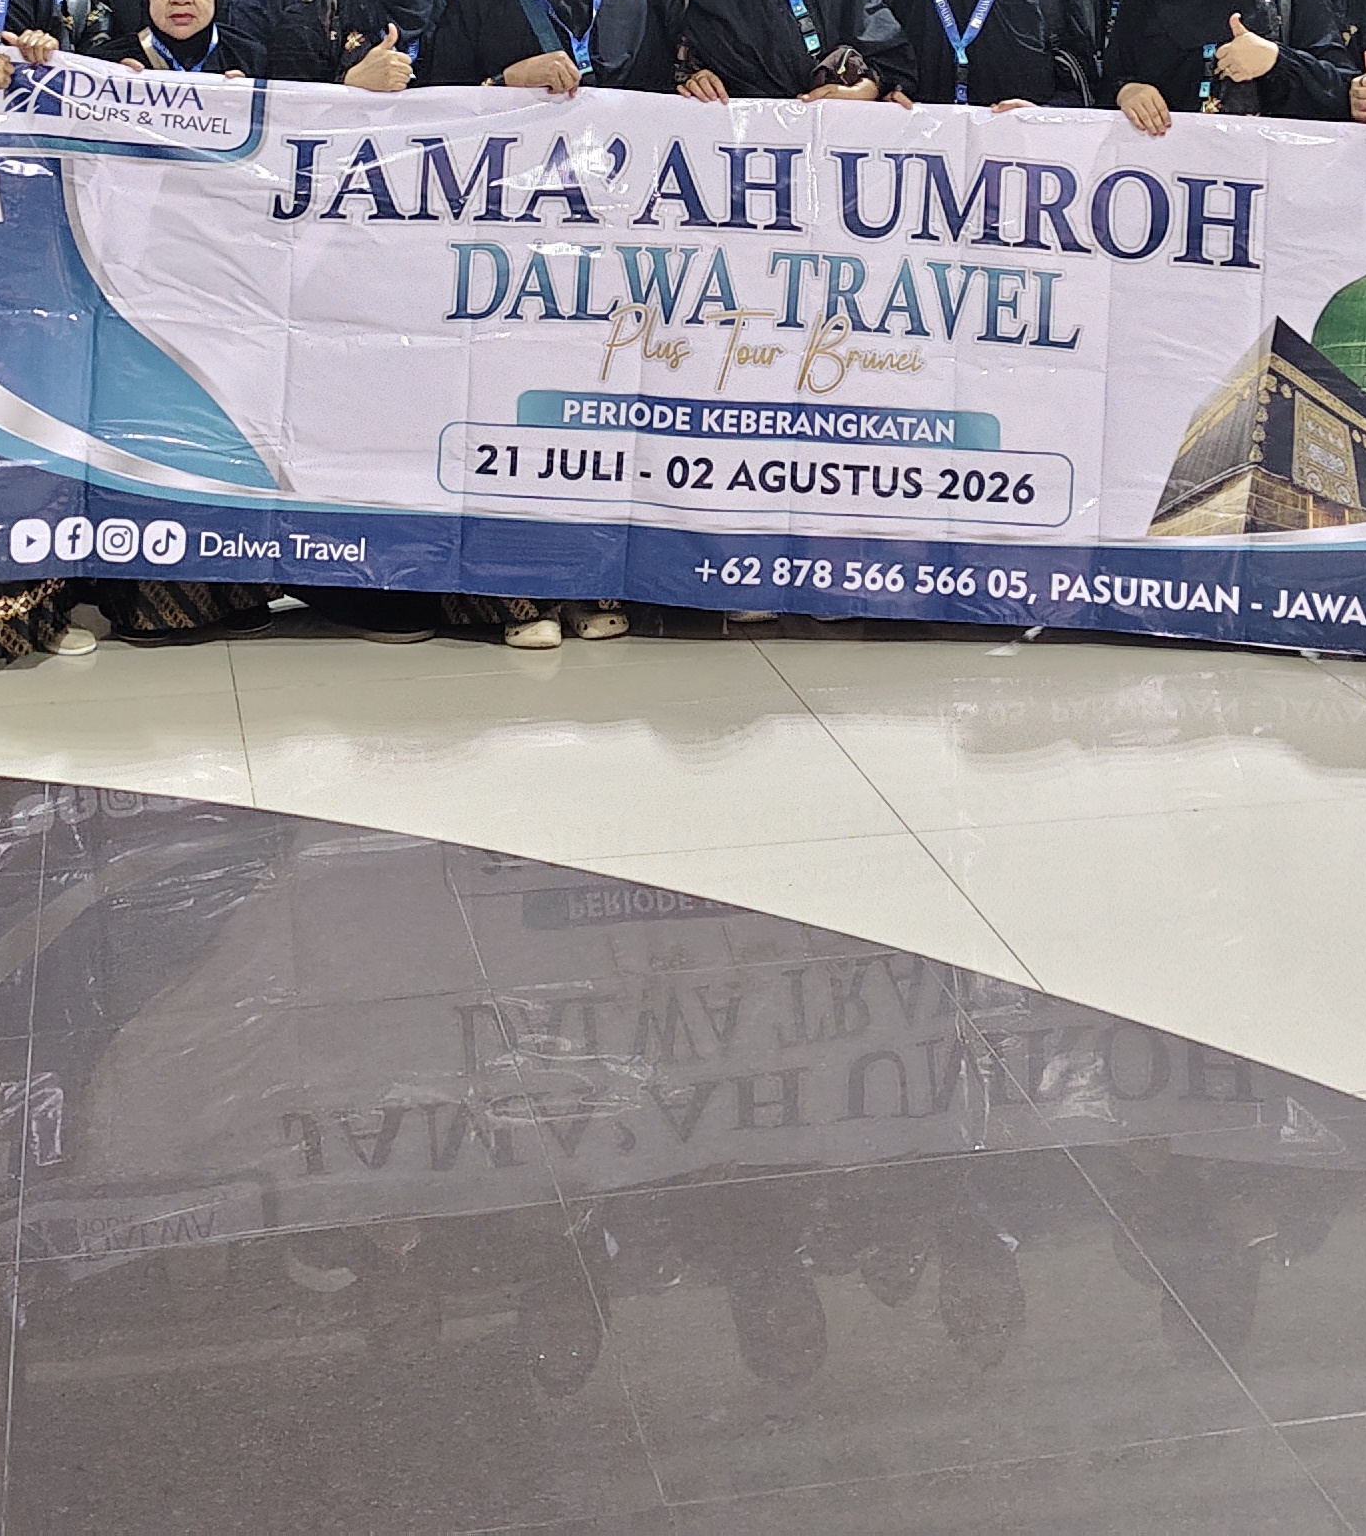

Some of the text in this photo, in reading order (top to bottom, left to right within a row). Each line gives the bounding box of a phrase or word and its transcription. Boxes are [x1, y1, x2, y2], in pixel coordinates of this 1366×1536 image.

[937, 1, 953, 26] DALWA
[68, 69, 205, 112] DALWA
[63, 100, 233, 136] TOURS & TRAVEL
[831, 150, 1266, 270] UMROH
[446, 240, 1083, 351] DALWA TRAVEL
[599, 305, 926, 395] Plus Tour Brunei
[562, 398, 956, 444] PERIODE KEBERANGKATAN
[475, 443, 520, 479] 21
[536, 447, 626, 483] JULI
[666, 451, 716, 491] 02
[726, 454, 924, 501] AGUSTUS
[936, 467, 1036, 507] 2026
[199, 529, 366, 564] Dalwa Travel
[694, 555, 762, 587] +62
[772, 556, 833, 592] 878
[842, 560, 905, 595] 566
[914, 564, 978, 599] 566
[986, 569, 1038, 607] 05,
[1050, 573, 1240, 617] PASURUAN
